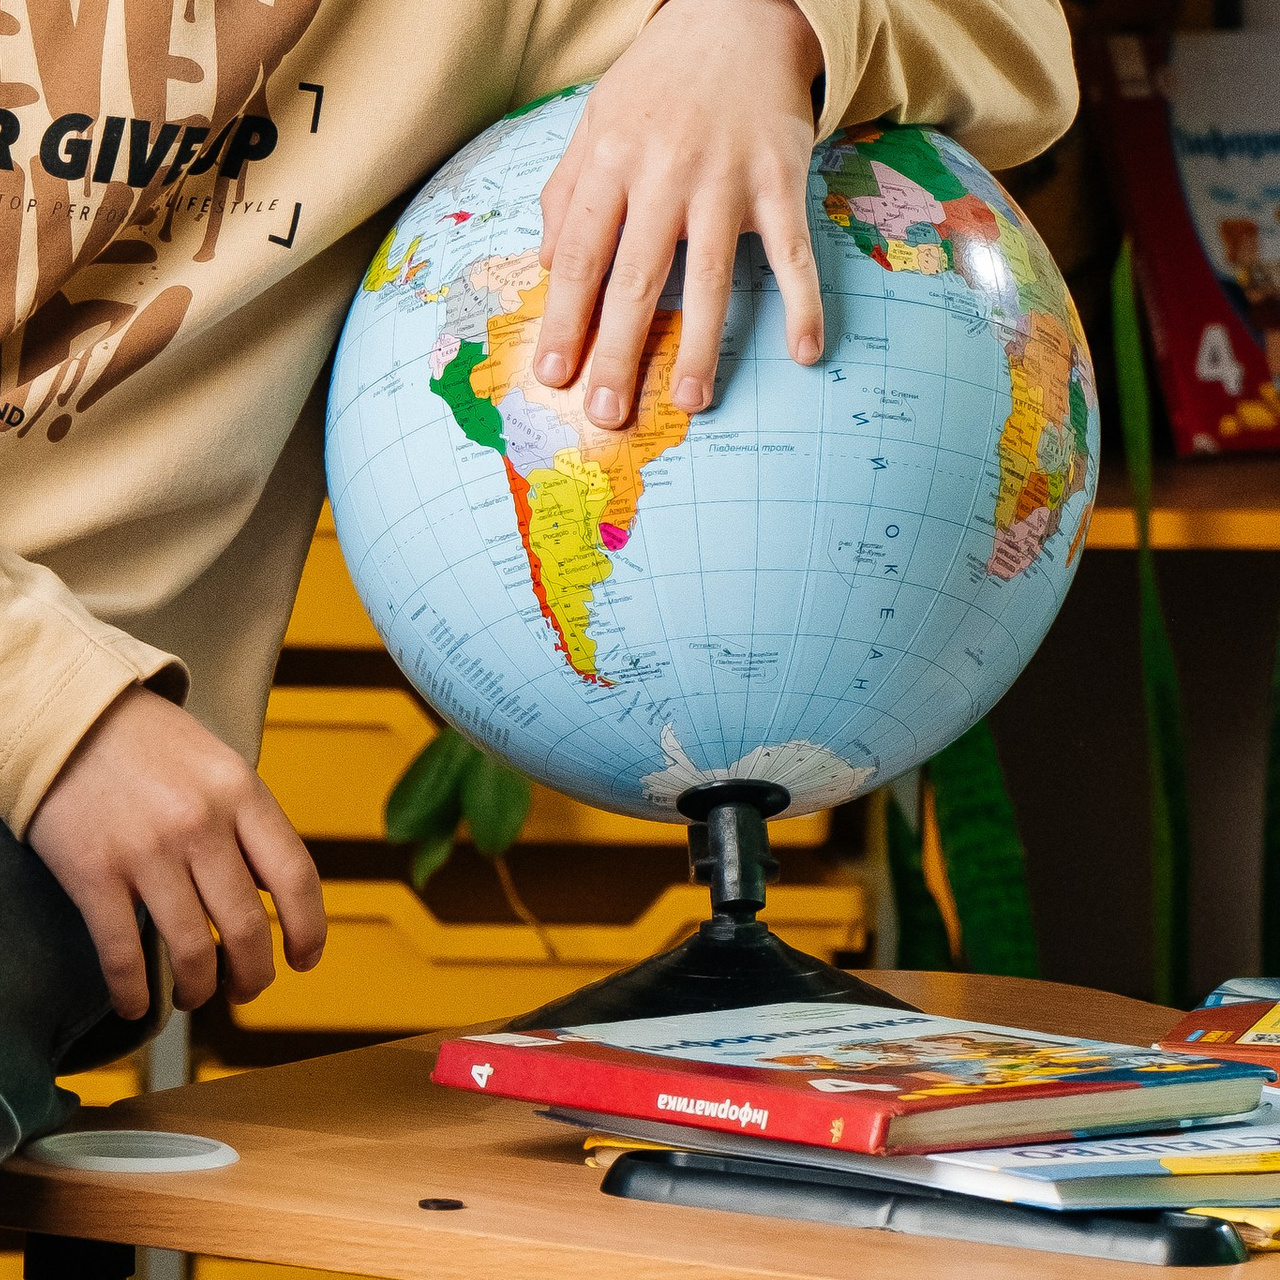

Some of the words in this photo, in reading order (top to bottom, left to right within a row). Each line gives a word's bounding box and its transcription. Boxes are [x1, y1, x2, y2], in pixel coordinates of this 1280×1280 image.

[516, 165, 544, 178] МОРЕ
[885, 289, 895, 298] 10
[891, 388, 920, 401] Єлени
[505, 412, 543, 442] БОЛІВІЯ
[708, 443, 759, 453] Південний
[761, 443, 796, 454] тропік
[542, 529, 570, 541] Росаріо
[630, 1016, 934, 1053] Інформатика
[471, 1063, 495, 1089] 4
[656, 1093, 769, 1131] Інформатика
